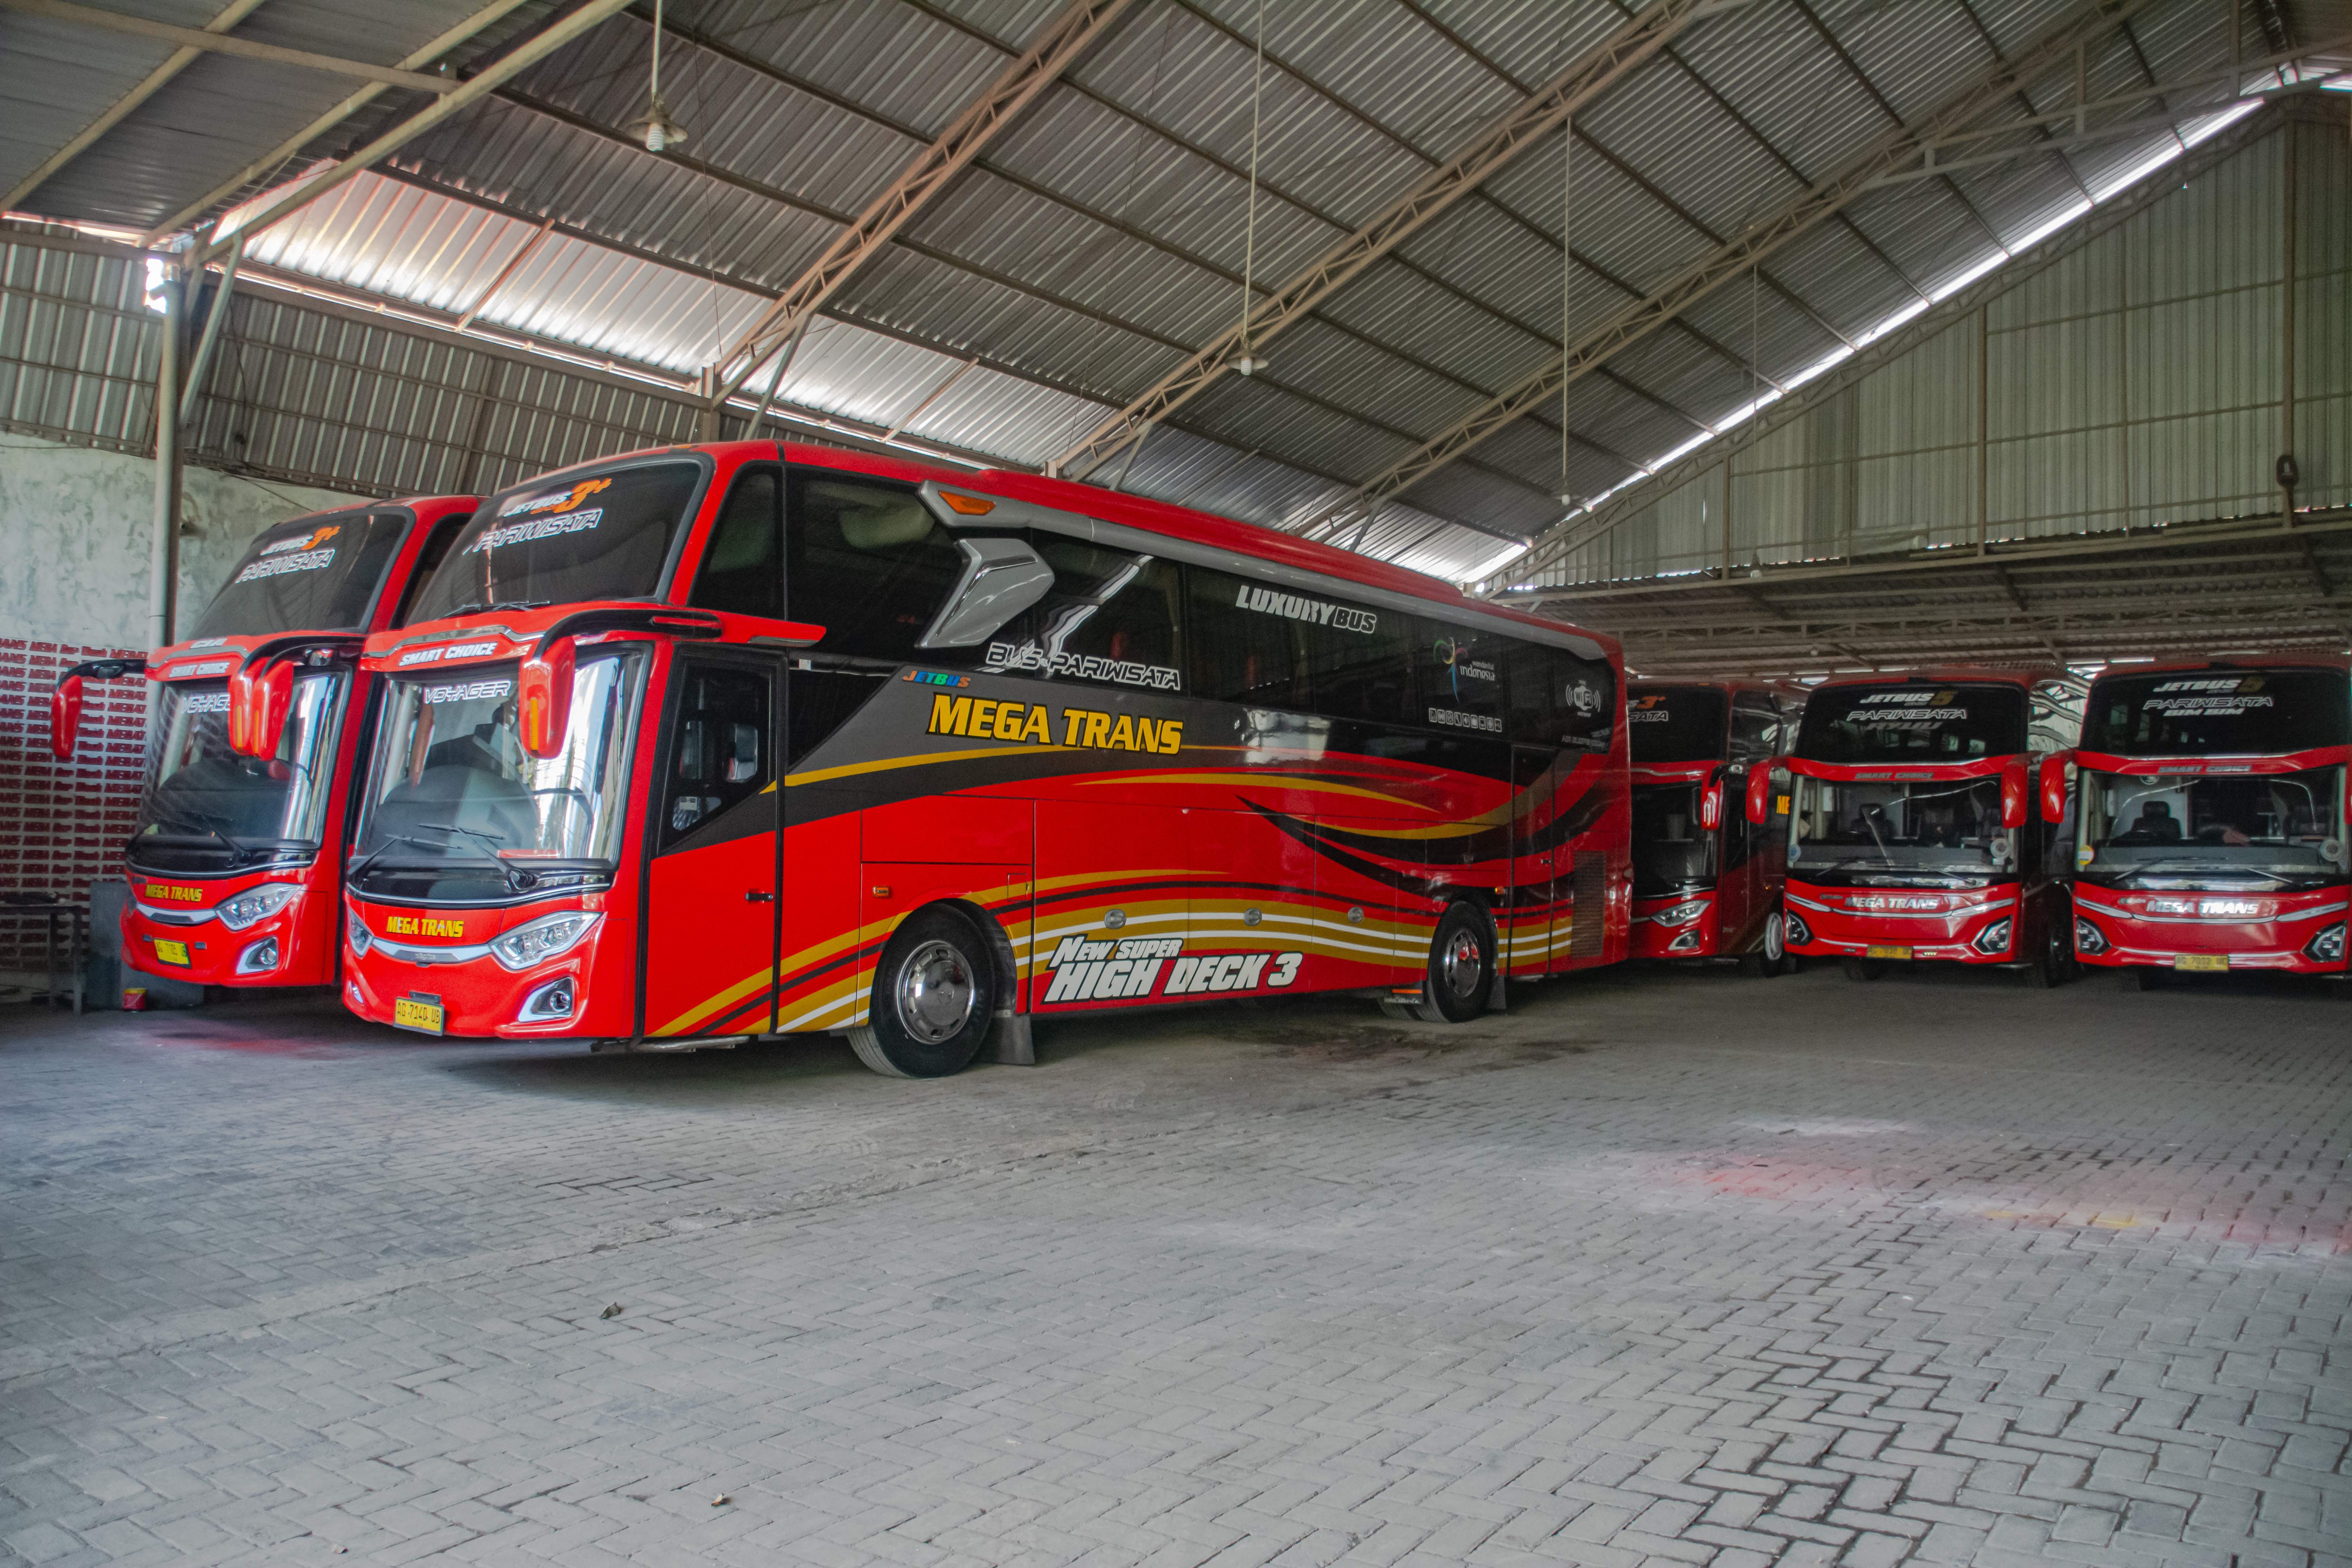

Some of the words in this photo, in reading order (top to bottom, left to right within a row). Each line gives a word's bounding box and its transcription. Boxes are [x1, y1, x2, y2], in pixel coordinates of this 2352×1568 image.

[472, 508, 603, 552] PARIWISATA
[235, 548, 336, 584] PARIWISATA
[1235, 585, 1336, 625] LUXURY
[1333, 606, 1377, 634] BUS
[398, 648, 445, 667] SMART
[443, 642, 498, 659] CHOICE
[169, 664, 198, 678] SMART
[196, 661, 230, 675] CHOICE
[902, 670, 971, 688] JETBUS
[1047, 652, 1181, 691] PARIWISATA
[424, 680, 512, 705] VOYAGER
[2152, 679, 2242, 692] JETBUS
[1859, 693, 1935, 704] JETBUS
[2142, 696, 2274, 710] PARIWISATA
[927, 693, 1053, 744] MEGA
[1062, 708, 1185, 755] TRANS
[1846, 709, 1967, 722] PARIWISATA
[145, 884, 169, 899] MEGA
[169, 886, 203, 902] TRANS
[1845, 896, 1885, 909] MEGA
[1889, 898, 1938, 910] TRANS
[2146, 900, 2195, 913] MEGA
[2198, 901, 2261, 914] TRANS
[386, 916, 419, 935] MEGA
[420, 918, 465, 938] TRANS
[1116, 937, 1183, 960] SUPER
[1043, 958, 1162, 1003] HIGH
[1163, 953, 1271, 995] DECK
[1267, 951, 1303, 988] 3
[397, 1002, 406, 1016] AG
[410, 1004, 427, 1021] 7140
[432, 1008, 440, 1024] UB
